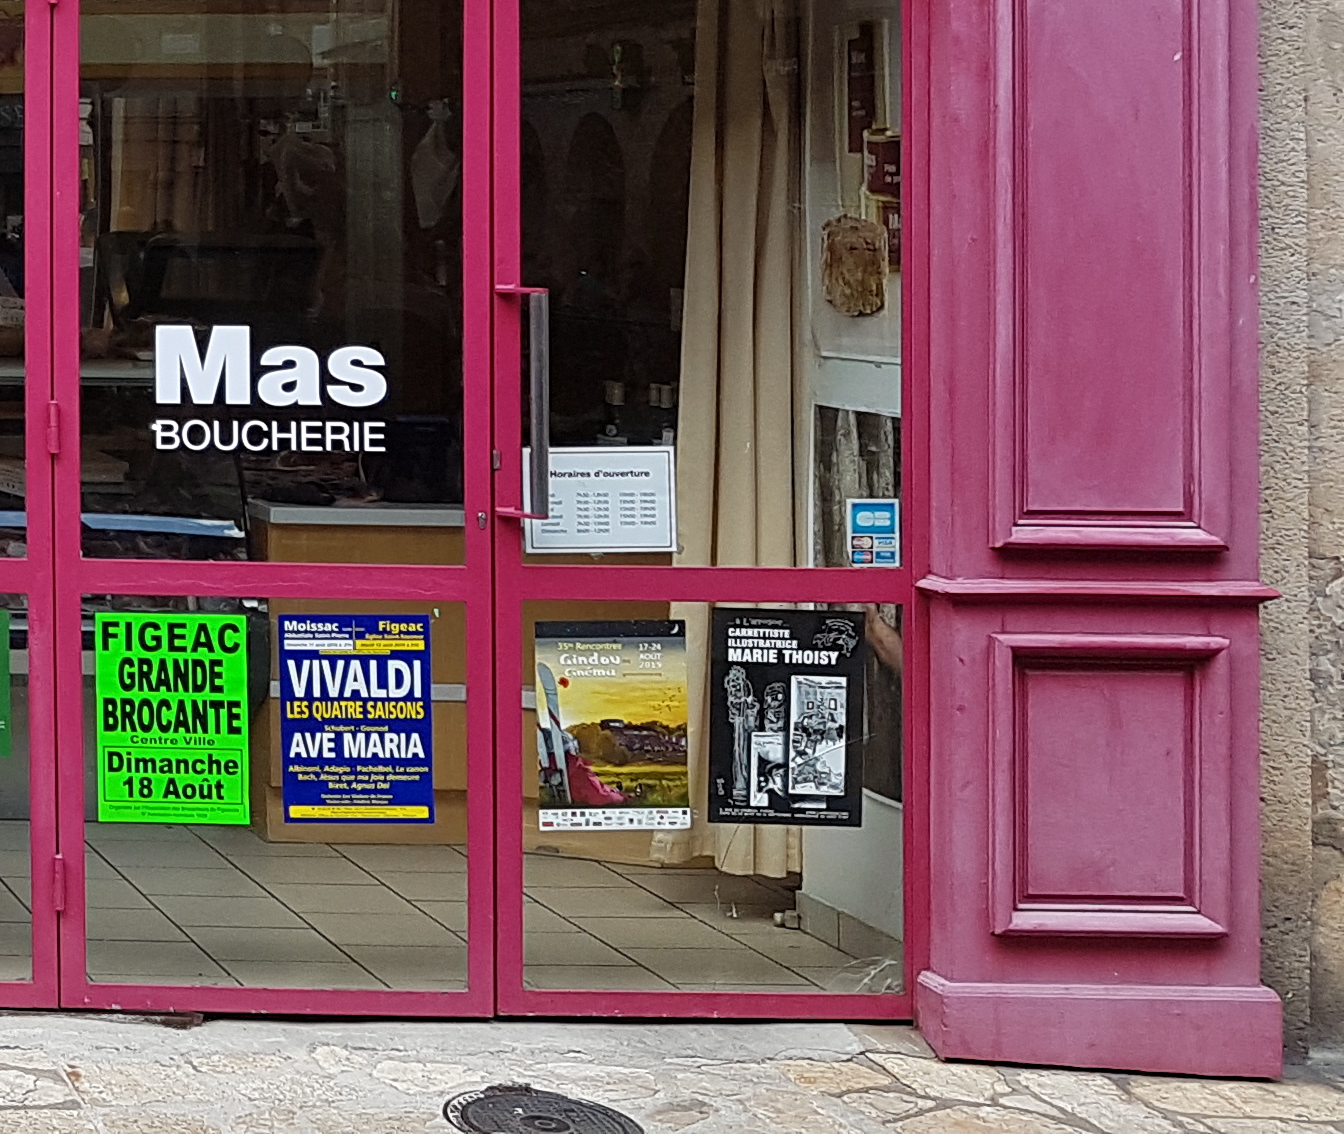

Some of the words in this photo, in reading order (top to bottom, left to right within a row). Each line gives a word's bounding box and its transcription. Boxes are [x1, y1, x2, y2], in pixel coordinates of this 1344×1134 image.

[155, 325, 388, 407] Mas
[154, 419, 387, 452] BOUCHERIE
[550, 470, 591, 478] Horaires
[594, 470, 650, 478] d'ouverture
[284, 620, 339, 632] Moissac
[378, 621, 424, 634] Figeac
[727, 628, 790, 638] CARNETTISTE
[101, 621, 241, 654] FIGEAC
[727, 638, 799, 649] ILLUSTRATRICE
[559, 652, 621, 665] Gindou
[727, 648, 778, 663] MARIE
[782, 649, 839, 665] THOISY
[118, 657, 225, 694] GRANDE
[286, 659, 422, 699] VIVALDI
[564, 666, 617, 677] Cinéma
[102, 697, 243, 735] BROCANTE
[286, 701, 309, 719] LES
[313, 701, 364, 721] QUATRE
[367, 701, 425, 720] SAISONS
[130, 735, 179, 746] Centre
[183, 736, 216, 746] Ville
[289, 732, 336, 758] AVE
[343, 732, 425, 759] MARIA
[107, 751, 239, 776] Dimanche
[123, 776, 154, 799] 18
[162, 777, 225, 800] Août
